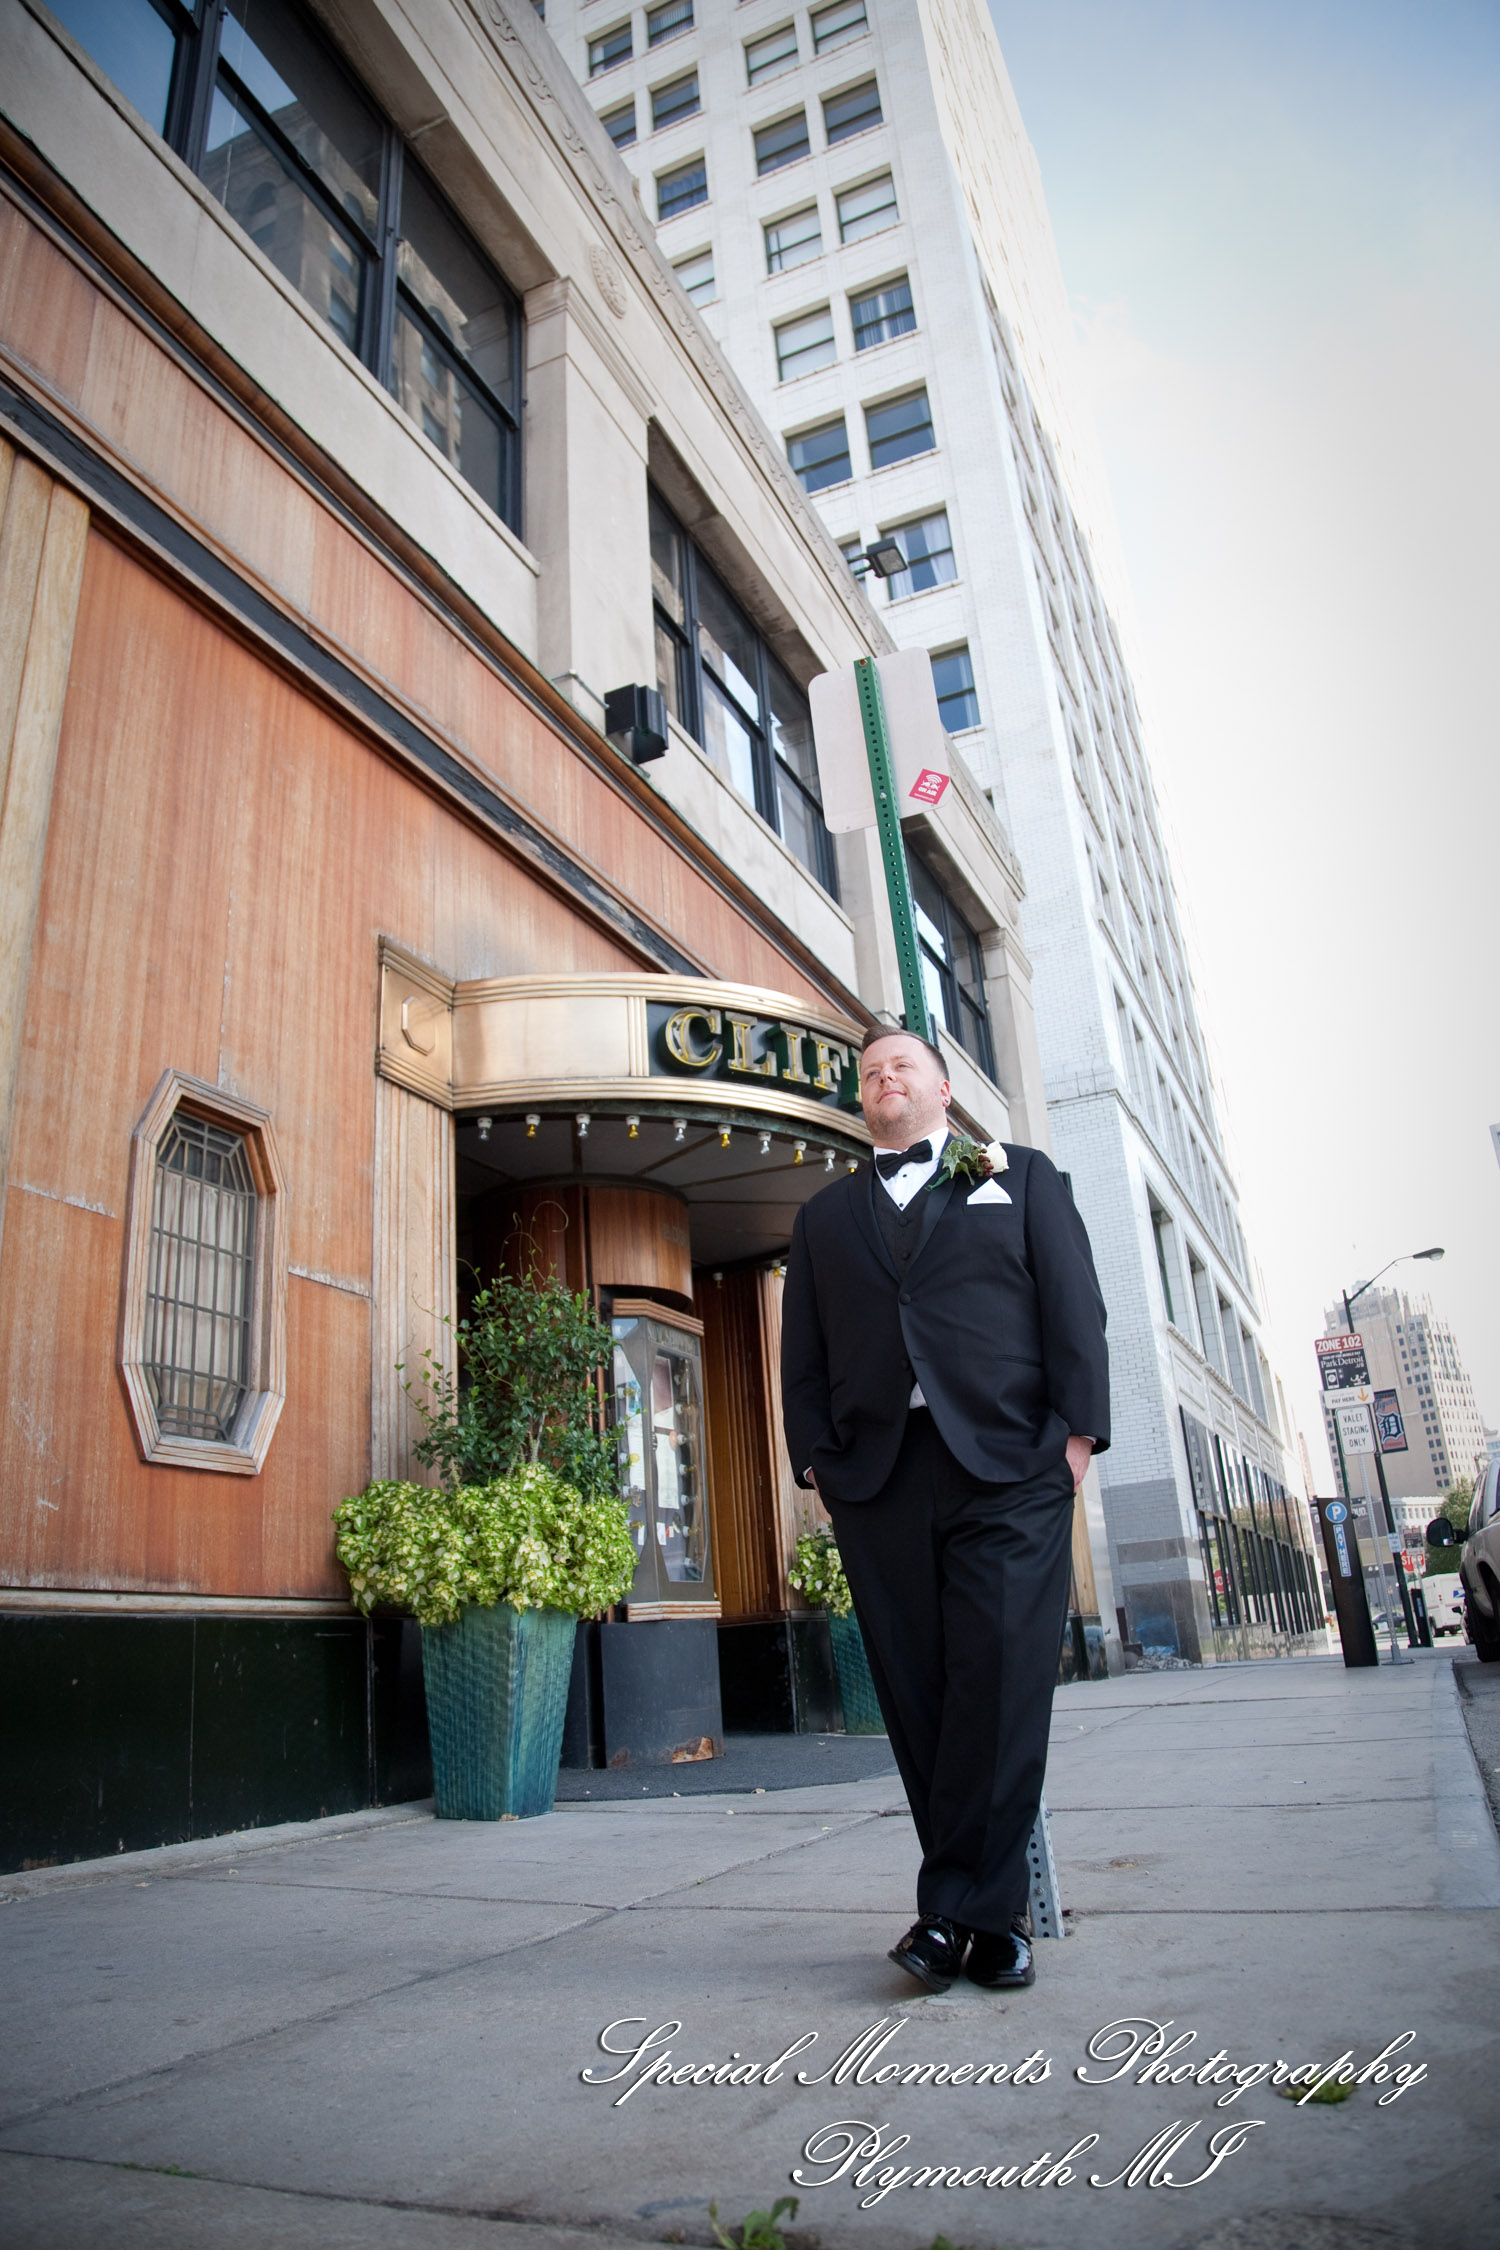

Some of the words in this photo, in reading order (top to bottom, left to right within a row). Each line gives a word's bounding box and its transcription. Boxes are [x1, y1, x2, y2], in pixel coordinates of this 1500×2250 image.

[664, 1006, 863, 1102] CLIF
[1316, 1339, 1342, 1352] ZONE
[1342, 1335, 1362, 1348] 102
[1343, 1413, 1363, 1423] VALET
[1342, 1425, 1369, 1436] STAGING
[1349, 1438, 1366, 1447] ONLY
[1331, 1505, 1342, 1520] P
[1335, 1527, 1343, 1546] PAY
[1340, 1548, 1349, 1574] HERE
